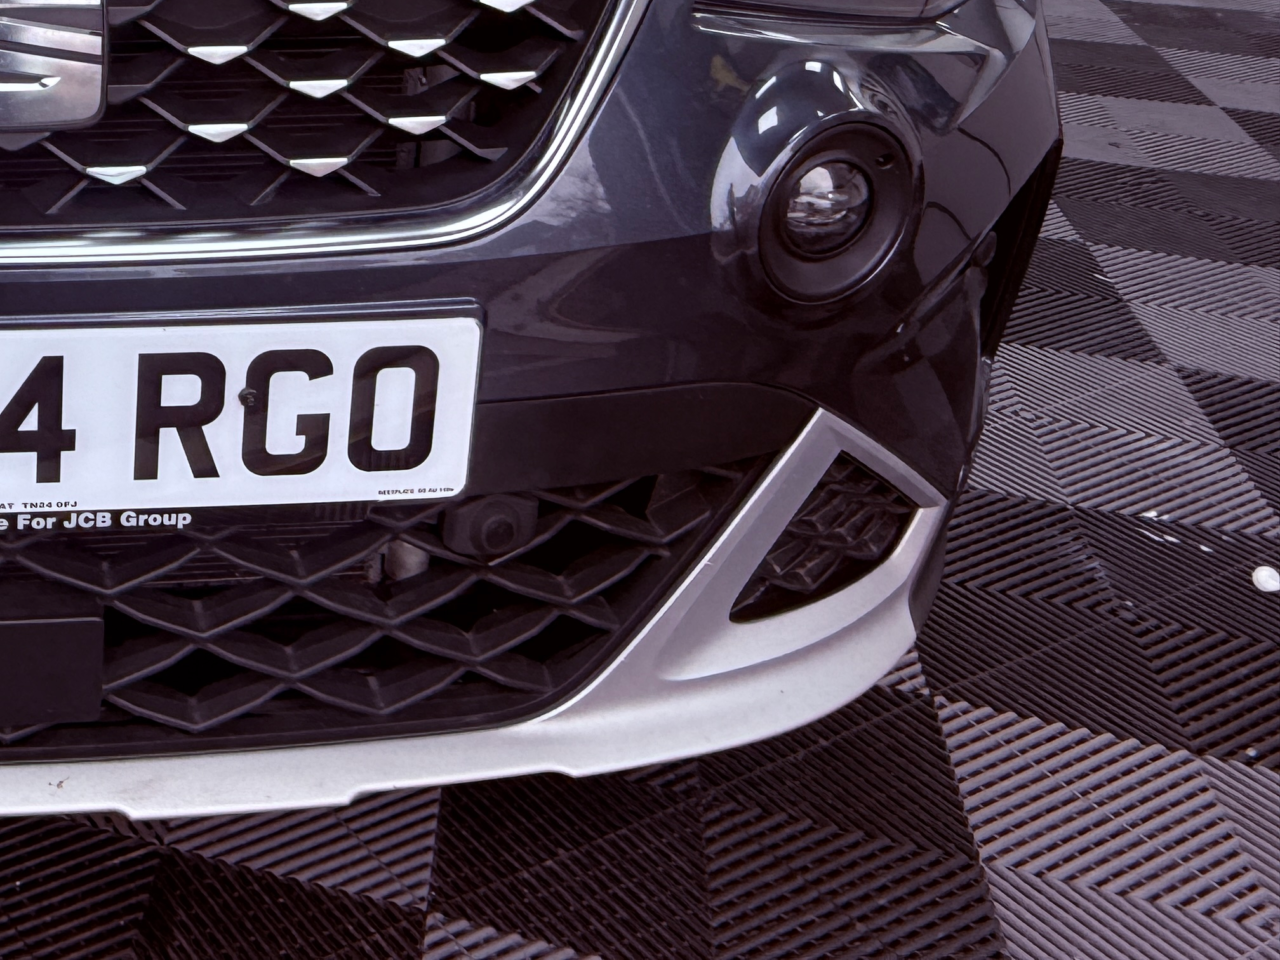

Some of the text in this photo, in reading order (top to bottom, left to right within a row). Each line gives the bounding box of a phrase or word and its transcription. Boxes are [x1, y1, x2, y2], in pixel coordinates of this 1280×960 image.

[133, 345, 439, 480] RGO
[17, 514, 56, 530] For
[63, 512, 112, 528] JCB
[120, 511, 192, 529] Group
